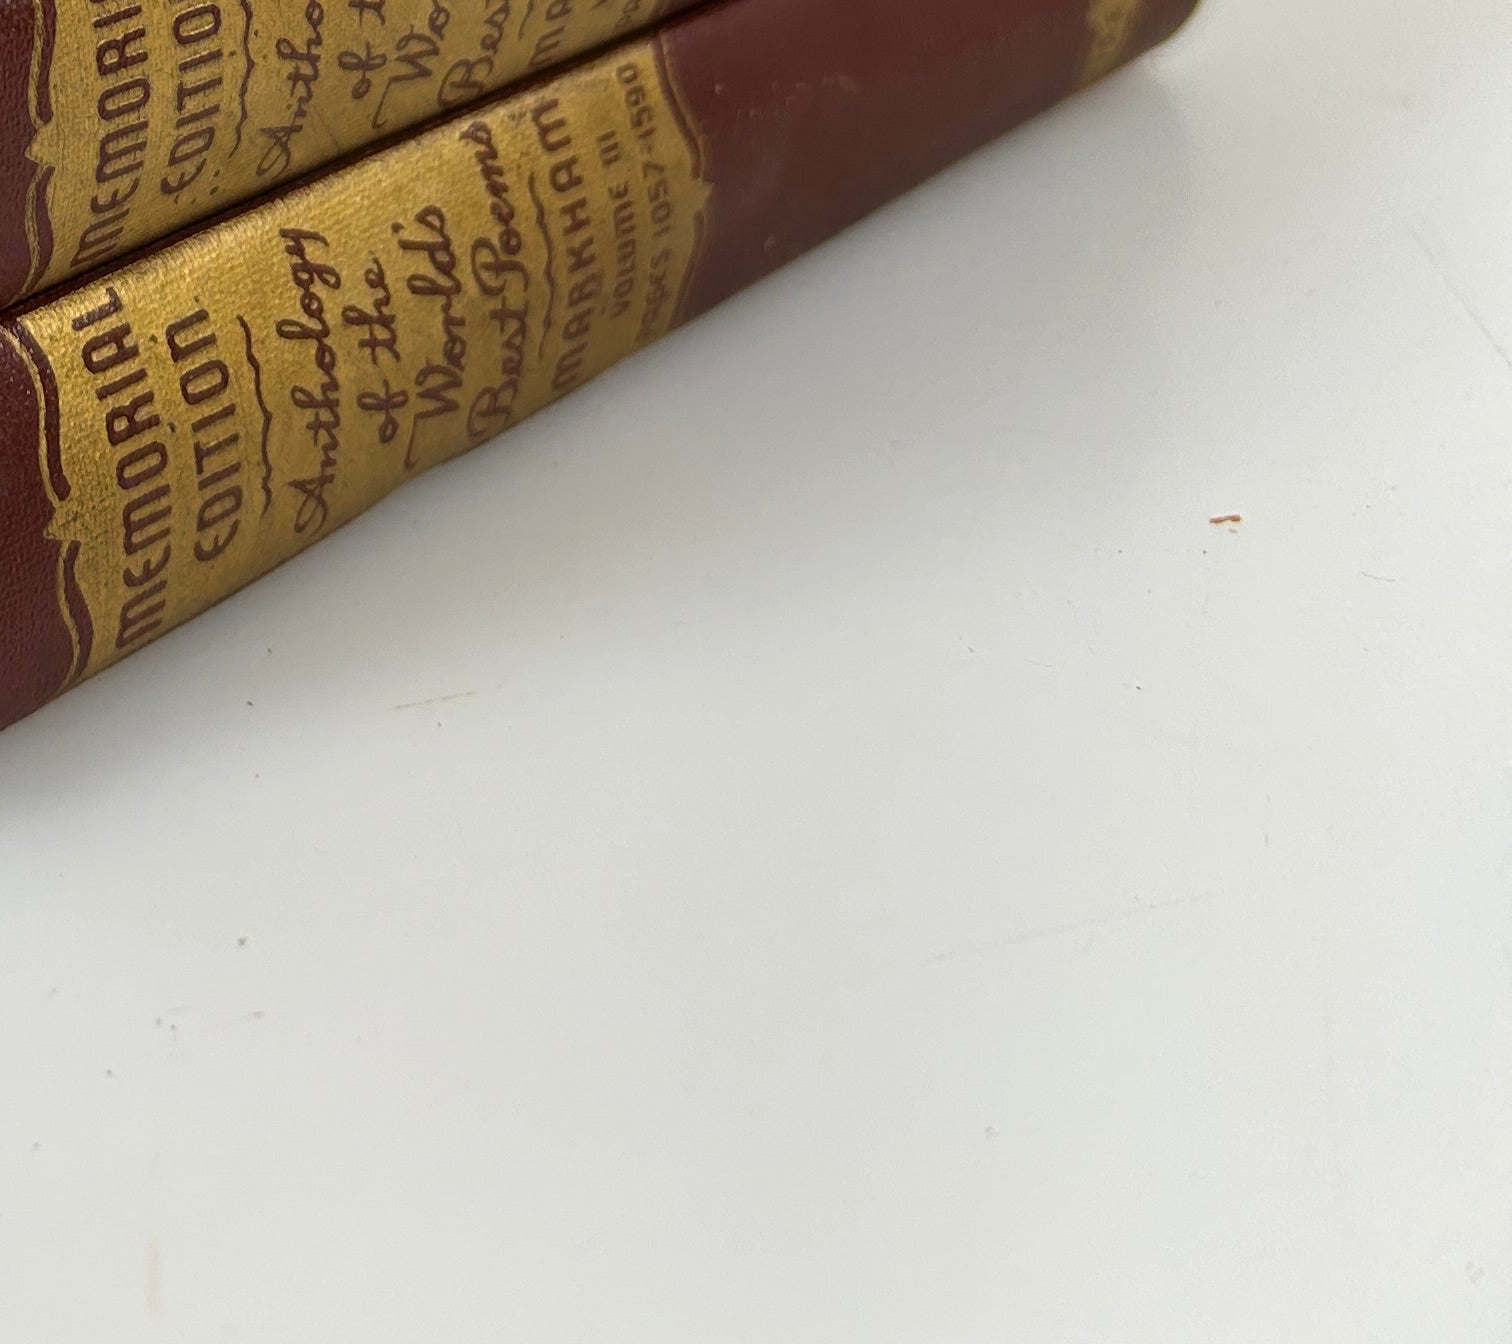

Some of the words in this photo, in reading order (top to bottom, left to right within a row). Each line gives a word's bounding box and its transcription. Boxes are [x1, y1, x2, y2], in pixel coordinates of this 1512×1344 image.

[338, 51, 387, 101] of
[596, 128, 622, 167] III
[459, 120, 526, 296] Poems
[532, 98, 595, 392] MARKHAM
[607, 180, 637, 320] VOLUME
[277, 226, 343, 537] Anthology
[342, 256, 400, 361] the
[390, 204, 466, 468] World's
[467, 296, 528, 437] Best
[73, 287, 173, 650] MEMORIAL
[165, 309, 243, 563] EDITION
[357, 386, 407, 443] of
